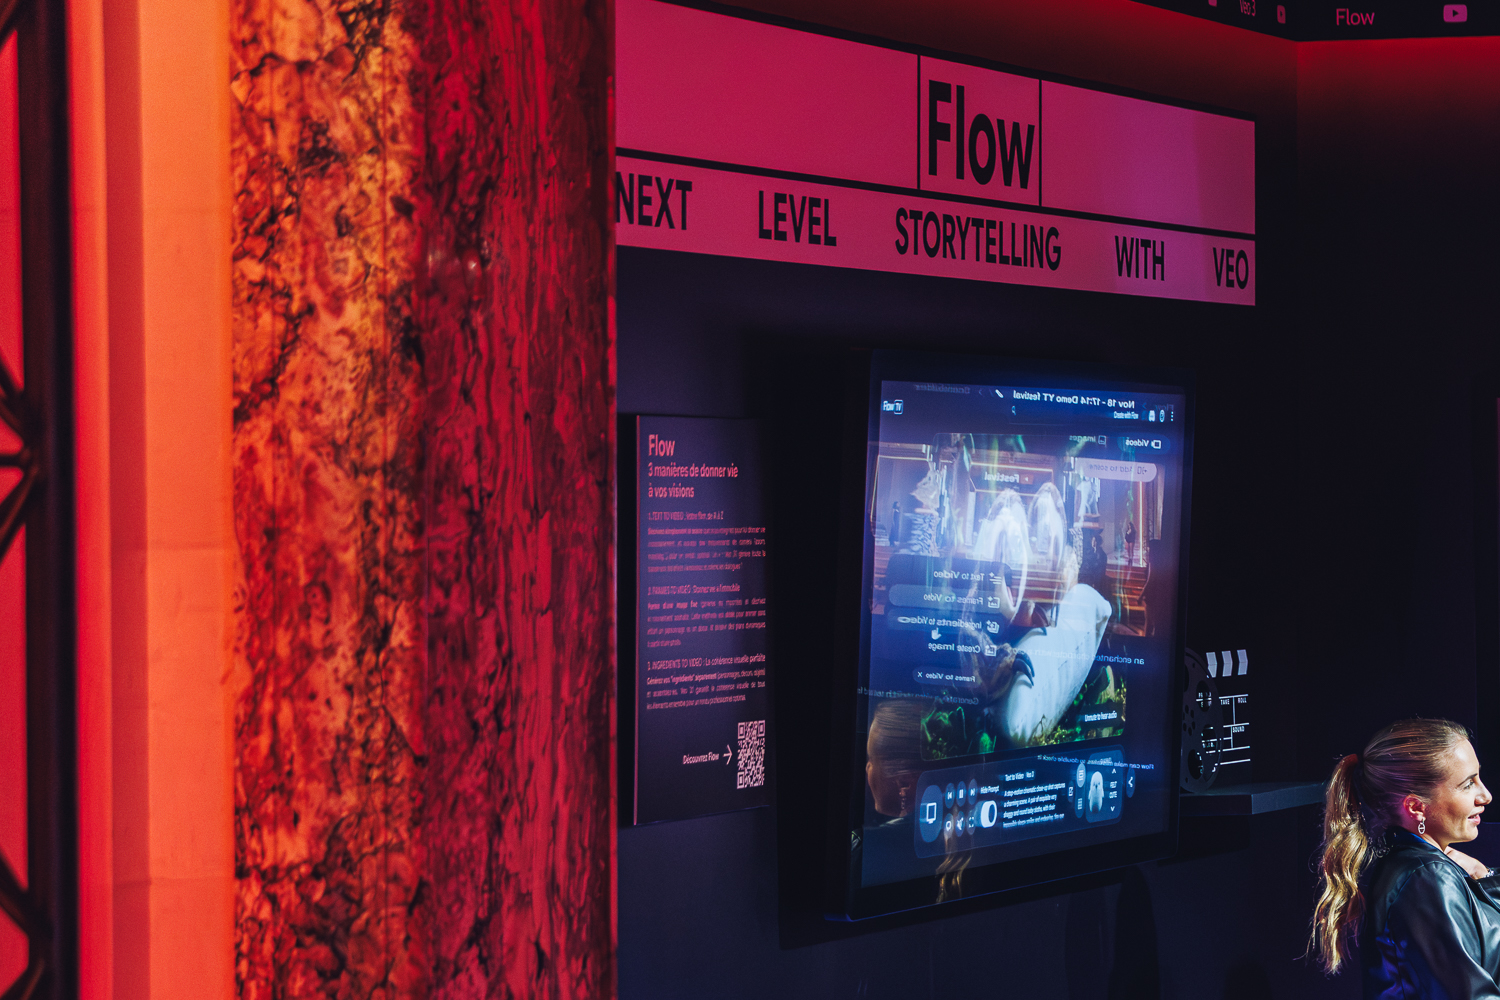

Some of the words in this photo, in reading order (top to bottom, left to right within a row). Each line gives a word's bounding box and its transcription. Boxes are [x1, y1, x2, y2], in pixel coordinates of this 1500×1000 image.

[1336, 8, 1375, 25] Flow
[928, 80, 1035, 190] Flow
[616, 171, 692, 230] NEXT
[758, 190, 837, 247] LEVEL
[895, 207, 1061, 272] STORYTELLING
[1115, 235, 1165, 282] WITH
[1212, 247, 1249, 290] VEO
[649, 434, 675, 456] Flow
[648, 462, 653, 477] 3
[654, 462, 688, 477] manières
[690, 463, 699, 477] de
[700, 463, 726, 477] donner
[727, 463, 738, 477] vie
[648, 482, 654, 498] à
[654, 487, 668, 498] vos
[668, 482, 695, 498] visions
[683, 754, 708, 765] Découvrez
[708, 752, 720, 762] Flow
